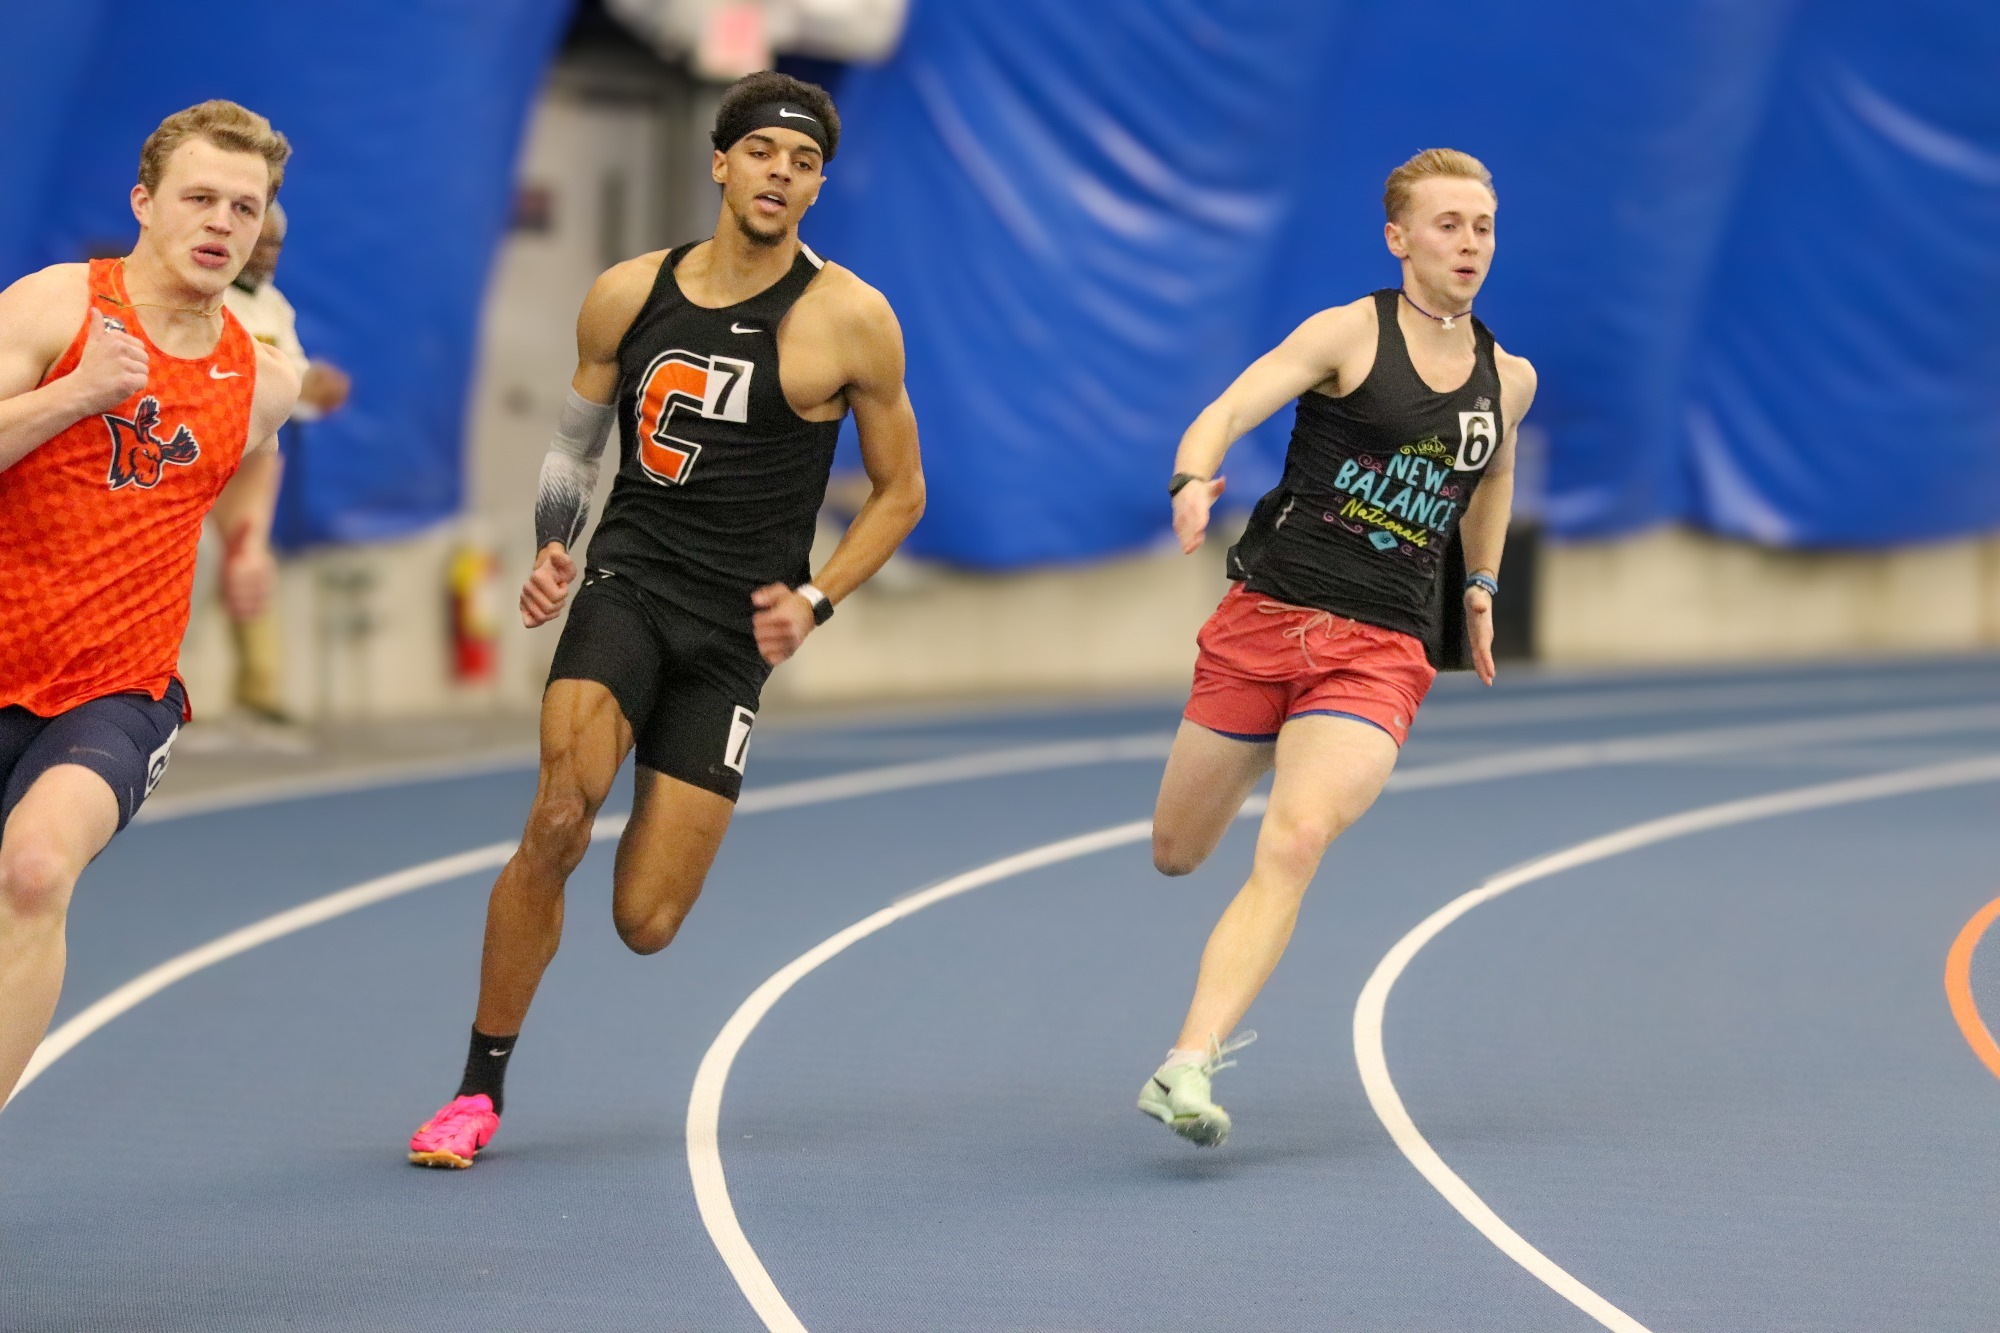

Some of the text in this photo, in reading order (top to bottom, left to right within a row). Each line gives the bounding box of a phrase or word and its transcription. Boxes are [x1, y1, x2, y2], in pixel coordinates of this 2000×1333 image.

[713, 360, 745, 415] 7
[1463, 416, 1489, 467] 6
[1386, 453, 1450, 494] NEW
[1340, 497, 1428, 548] Nationals
[734, 711, 754, 766] 7
